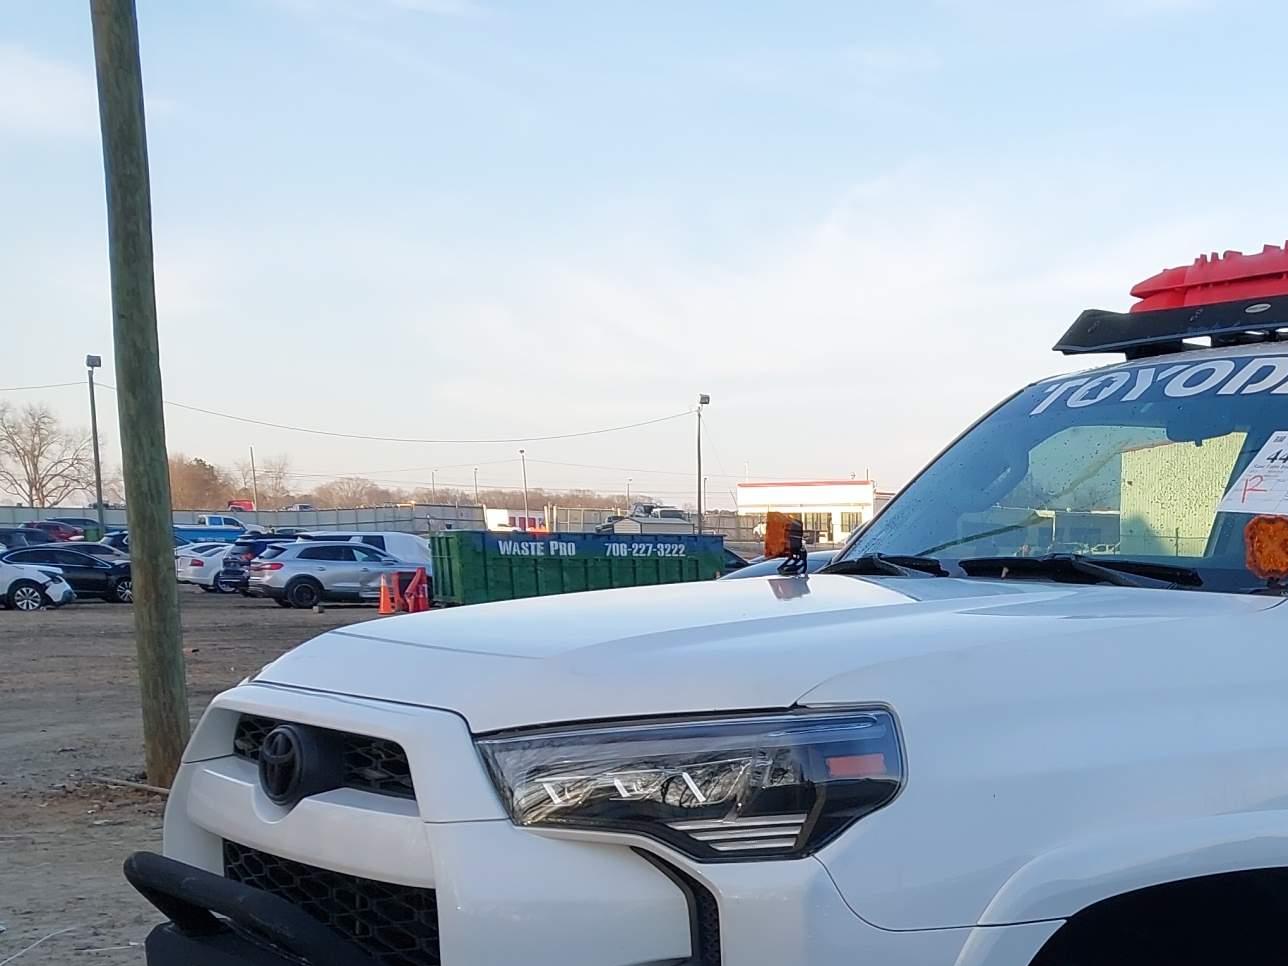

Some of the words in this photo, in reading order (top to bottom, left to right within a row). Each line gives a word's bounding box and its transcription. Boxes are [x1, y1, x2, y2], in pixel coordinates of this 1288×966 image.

[498, 540, 545, 556] WASTE
[549, 541, 576, 556] PRO
[604, 543, 686, 557] 706-227-3222
